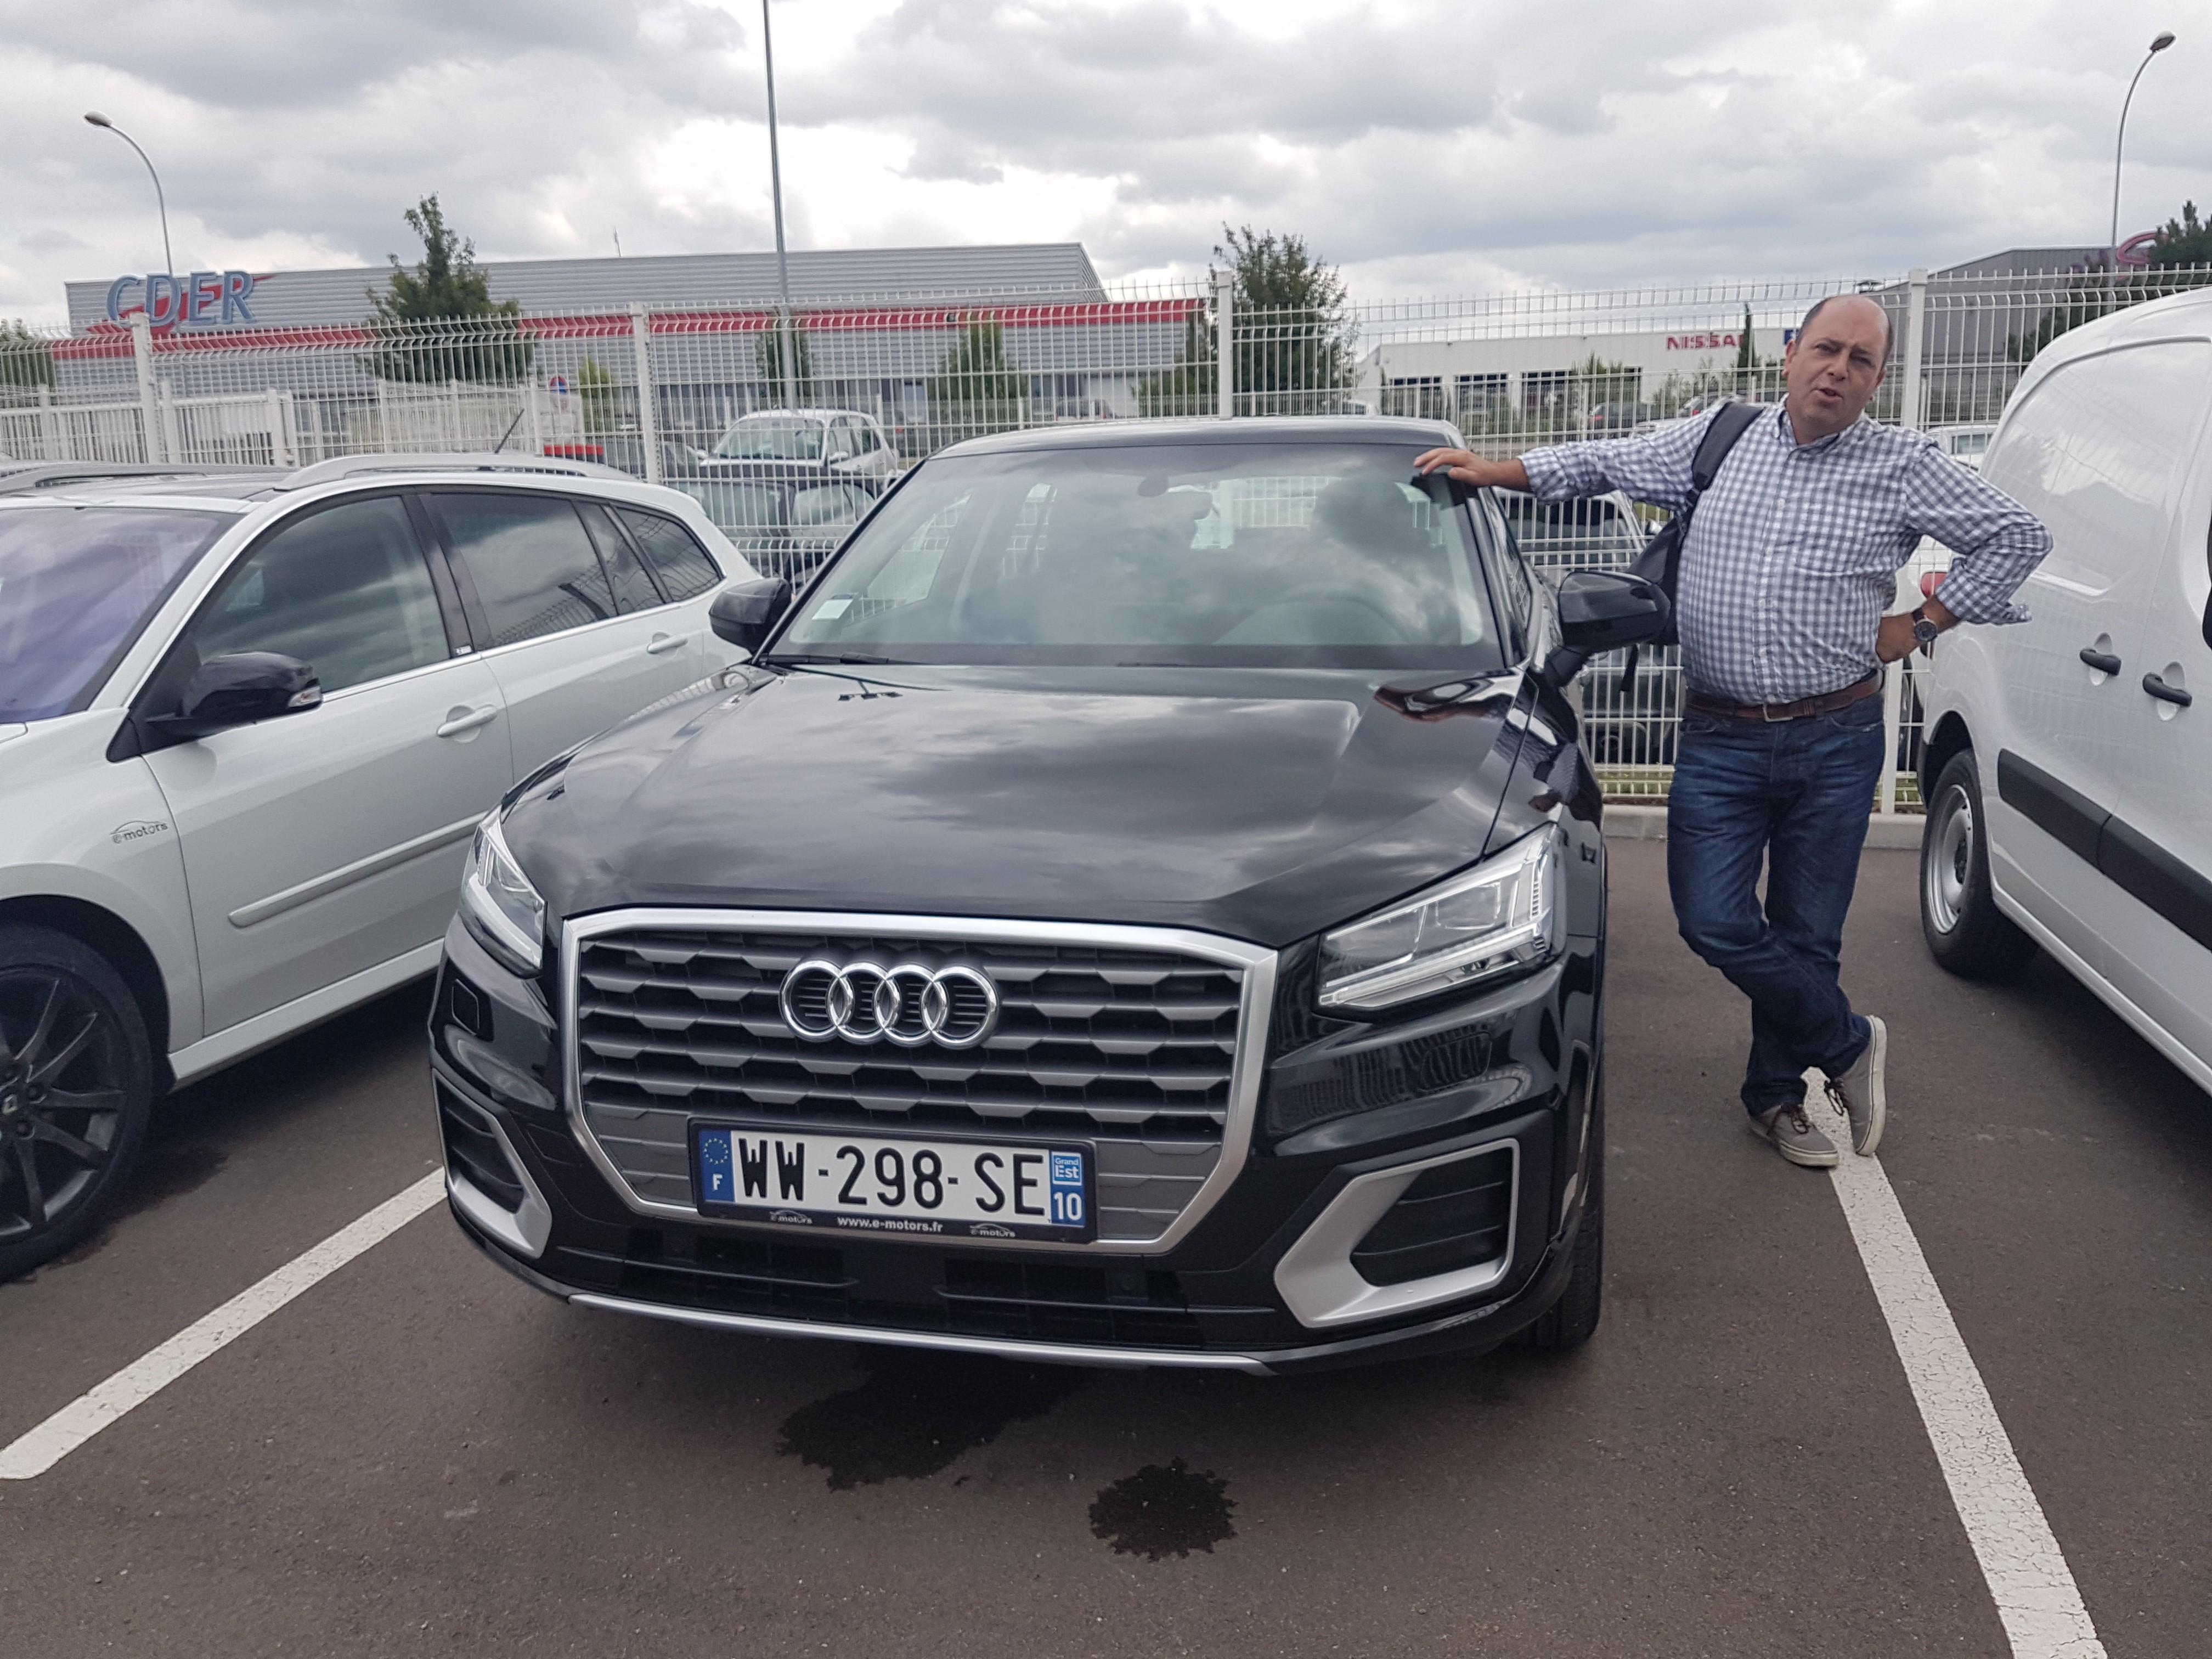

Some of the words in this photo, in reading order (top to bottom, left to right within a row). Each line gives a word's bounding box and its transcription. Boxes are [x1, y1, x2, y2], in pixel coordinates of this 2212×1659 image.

[107, 270, 255, 327] CDER
[1054, 1157, 1079, 1165] Grand
[738, 1137, 1046, 1216] WW-298-SE
[1055, 1165, 1079, 1178] Est
[712, 1173, 723, 1192] F
[1054, 1192, 1082, 1221] 10
[837, 1216, 944, 1232] www.e-motors.fr
